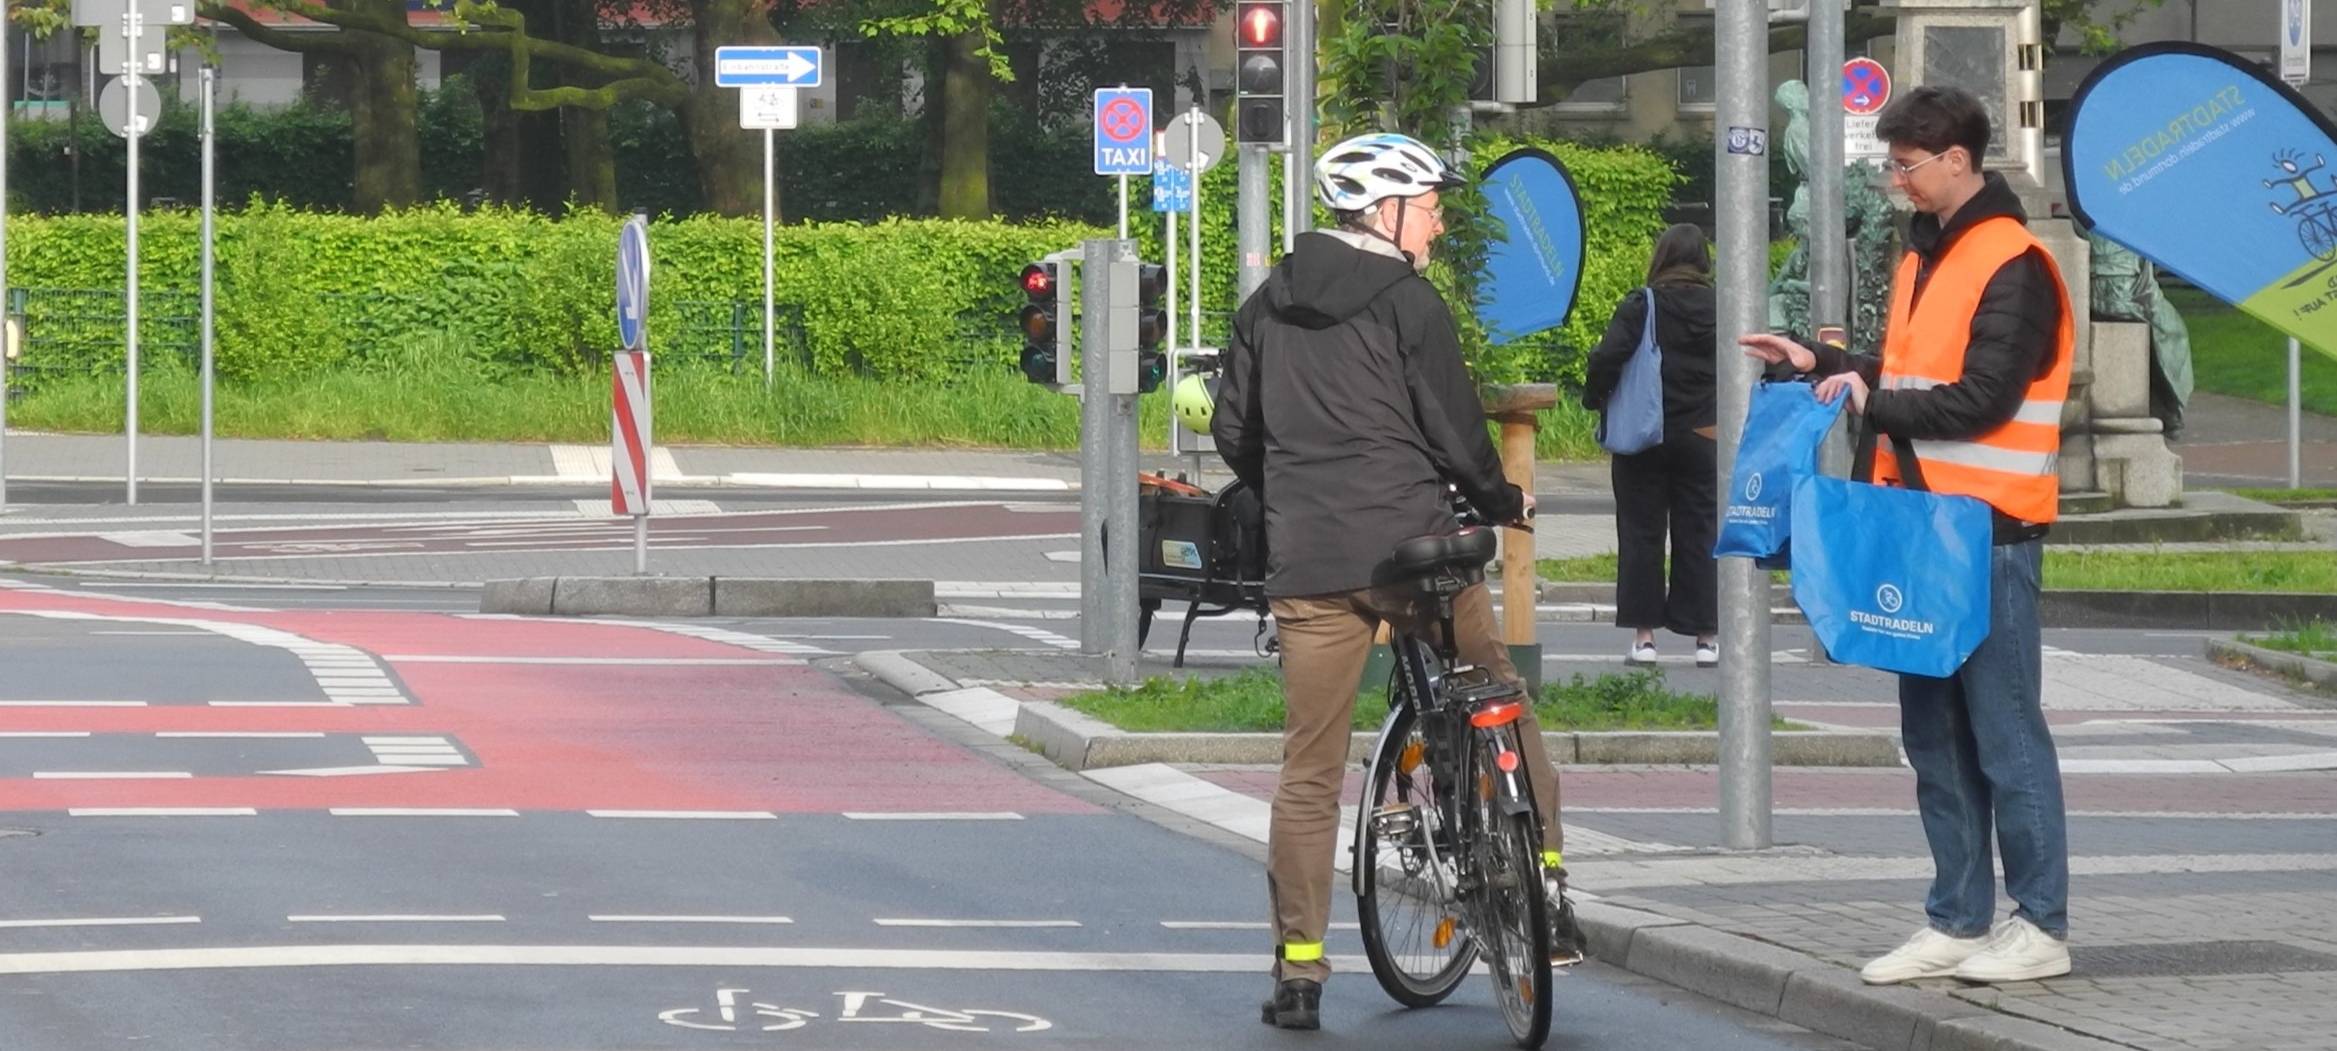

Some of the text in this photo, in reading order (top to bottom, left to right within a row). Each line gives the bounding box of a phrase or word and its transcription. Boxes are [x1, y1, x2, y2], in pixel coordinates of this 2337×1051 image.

[1855, 141, 1872, 150] frei
[1102, 147, 1146, 166] TAXI
[1509, 173, 1566, 278] STADTRADELN
[1850, 610, 1934, 634] STADTRADELN
